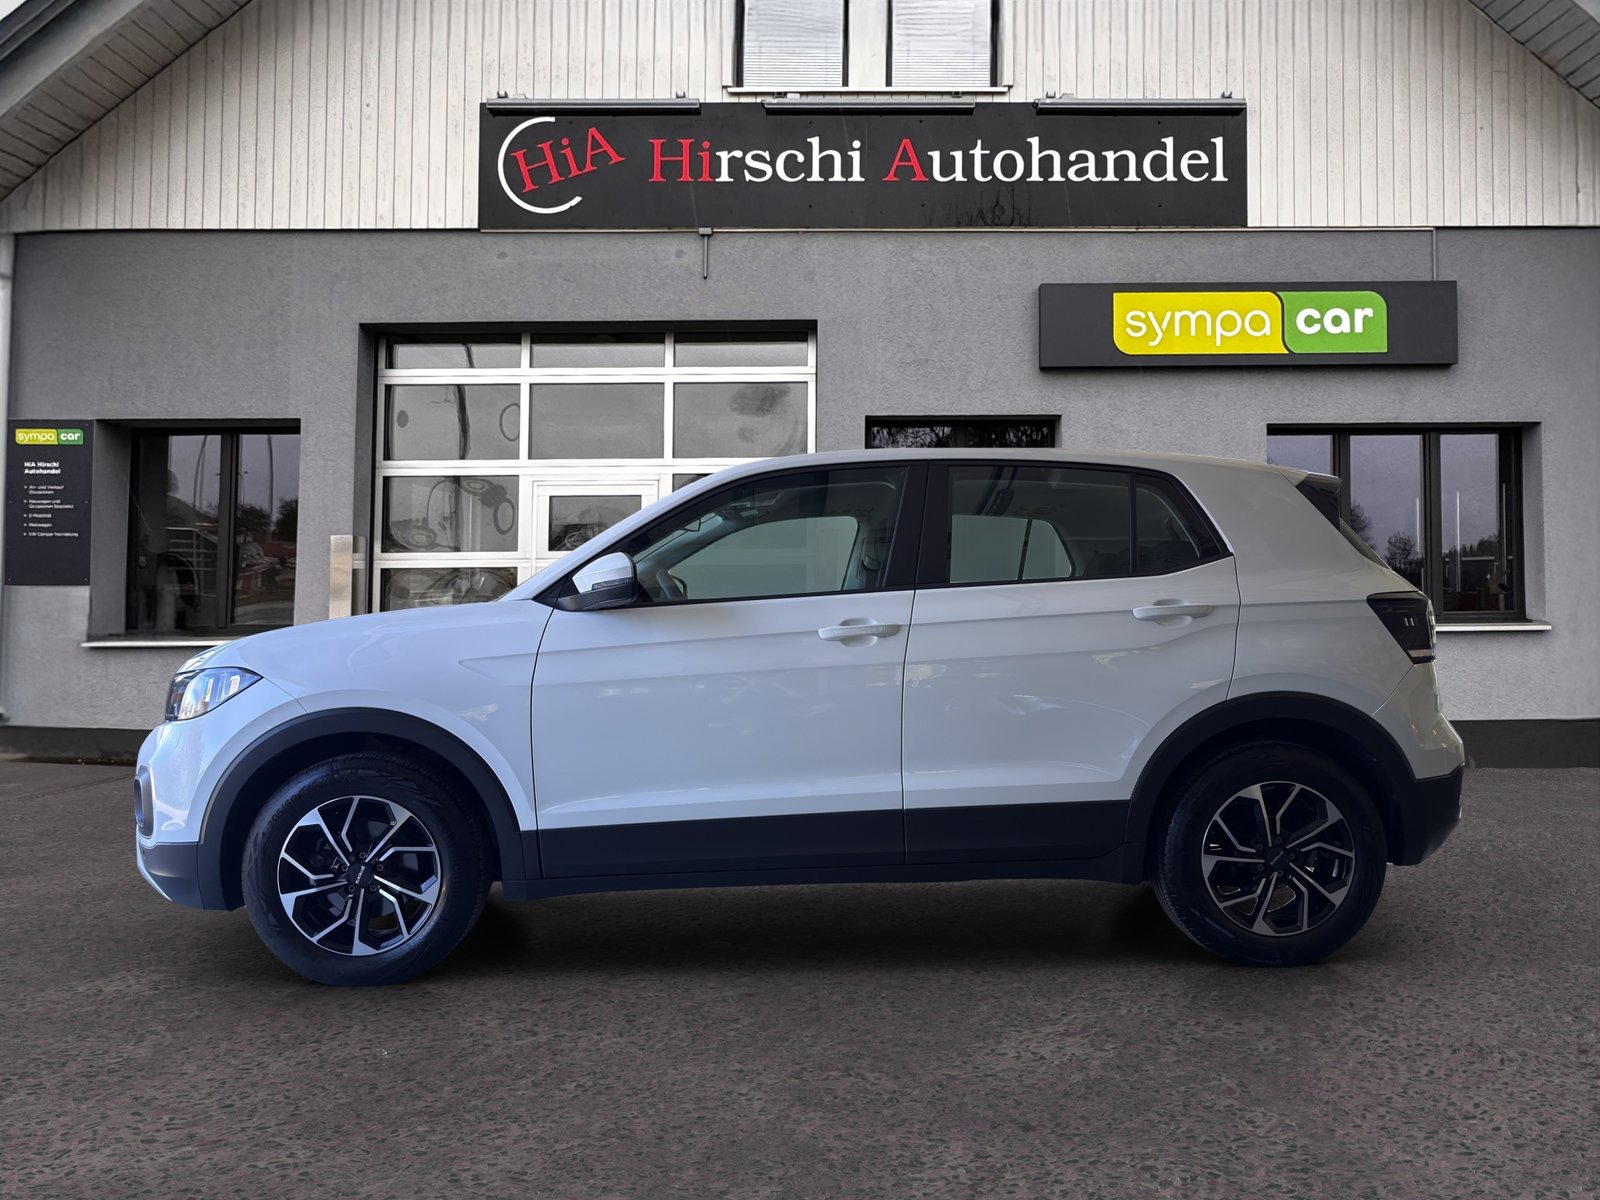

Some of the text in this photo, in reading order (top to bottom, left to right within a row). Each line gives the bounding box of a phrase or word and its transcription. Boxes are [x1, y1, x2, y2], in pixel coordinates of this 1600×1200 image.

[511, 127, 625, 193] HiA
[648, 136, 1229, 183] Hirschi Autohandel
[1125, 307, 1374, 347] sympa car
[18, 432, 81, 443] sympa car
